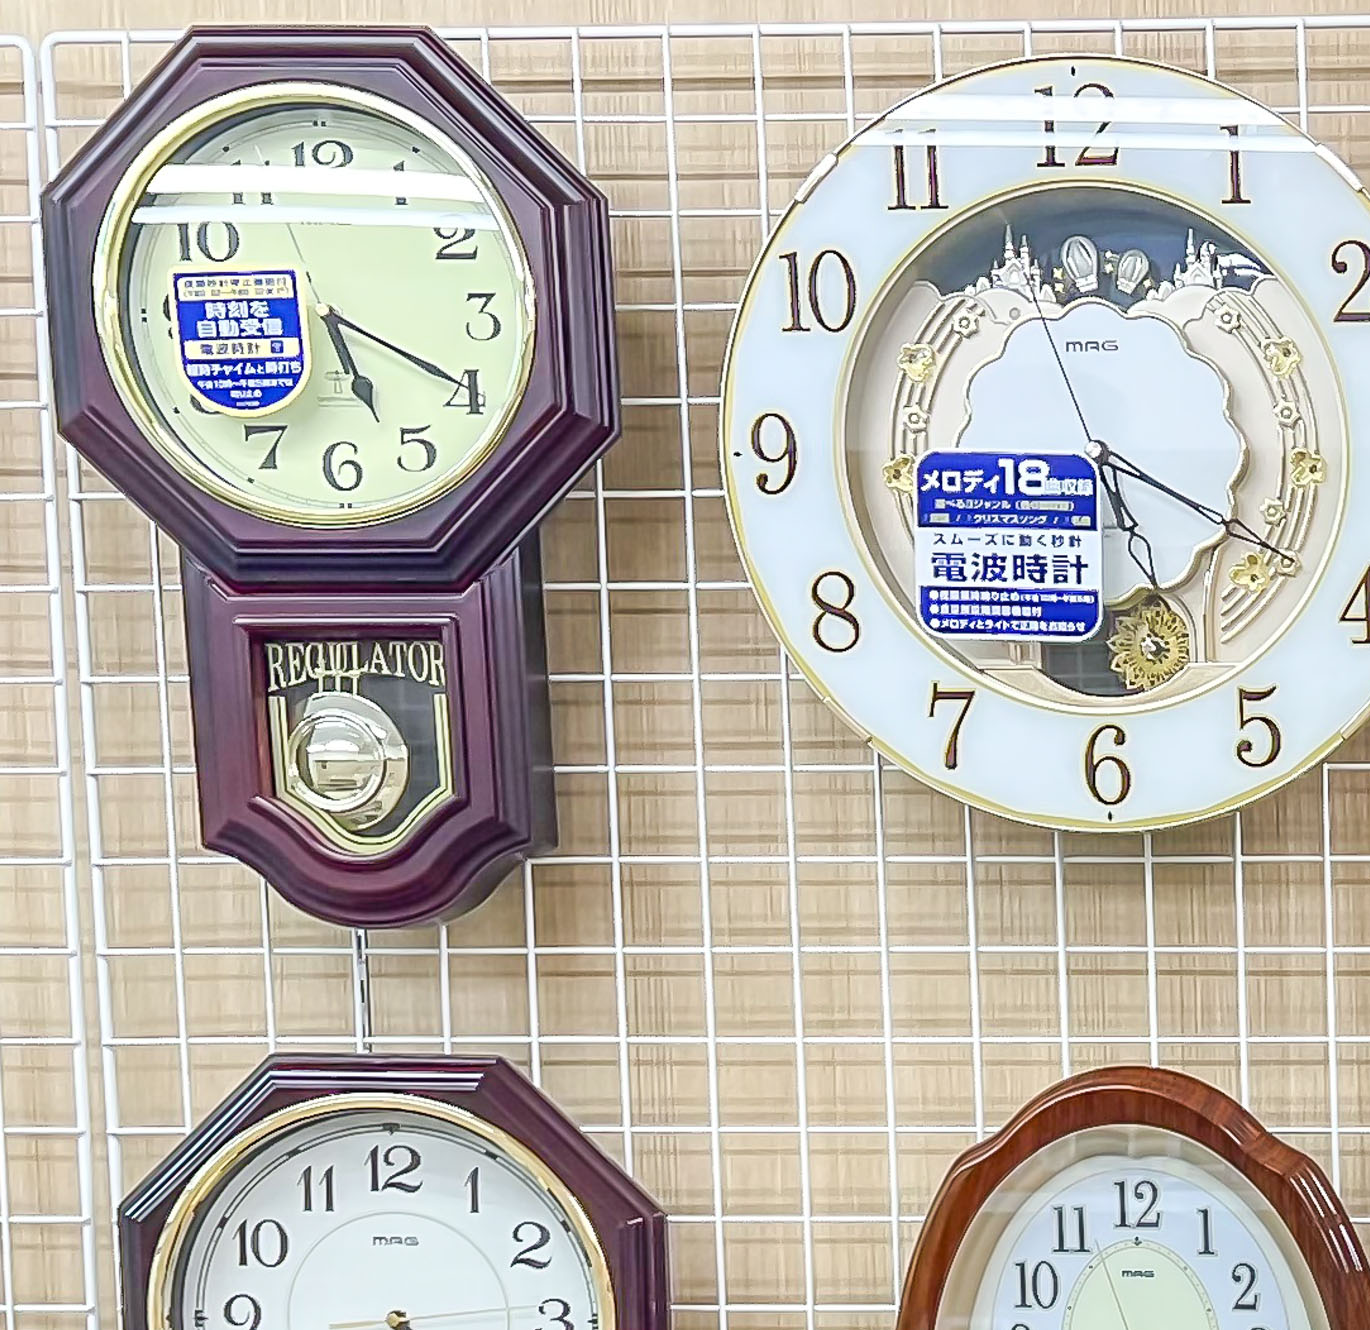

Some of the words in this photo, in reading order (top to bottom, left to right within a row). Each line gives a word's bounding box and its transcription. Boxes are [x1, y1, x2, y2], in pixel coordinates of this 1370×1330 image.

[1035, 83, 1119, 167] 12
[177, 222, 239, 262] 10
[205, 301, 269, 319] 時刻を
[779, 250, 856, 332] 10
[197, 318, 283, 338] 自動受信
[466, 293, 501, 340] 3
[1066, 340, 1120, 352] MAG
[244, 425, 287, 469] 7
[323, 442, 362, 491] 6
[752, 414, 797, 494] 9
[933, 533, 1082, 547] スムーズに動く秒針
[931, 552, 1088, 584] 電波時計
[265, 641, 446, 692] REGULATOR
[1237, 686, 1280, 767] 5
[370, 1145, 422, 1193] 12
[1114, 1181, 1160, 1227] 12
[233, 1220, 287, 1267] 10
[1015, 1261, 1058, 1309] 10
